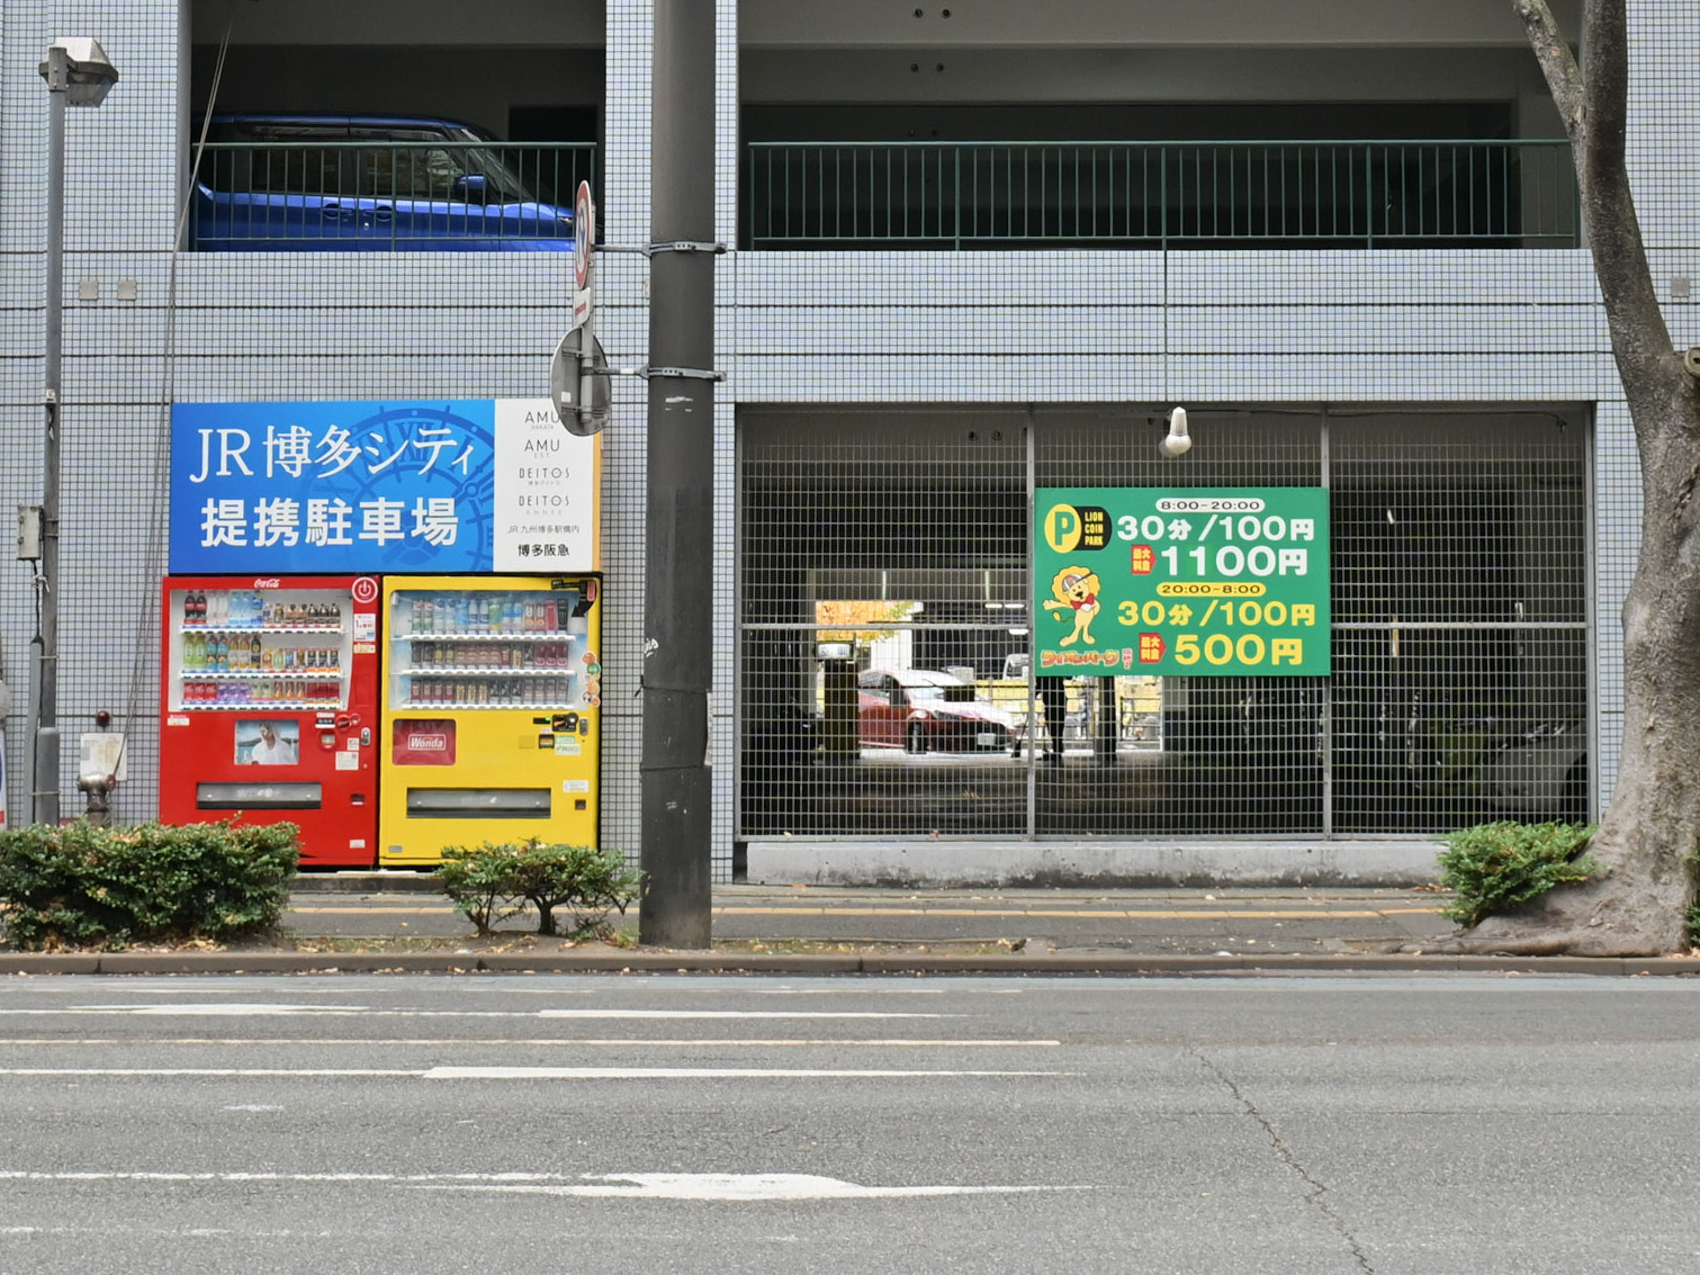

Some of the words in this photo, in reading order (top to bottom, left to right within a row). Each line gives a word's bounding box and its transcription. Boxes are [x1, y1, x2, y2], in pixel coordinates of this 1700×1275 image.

[524, 438, 560, 452] AMU
[518, 467, 570, 479] DEITOS
[518, 495, 570, 507] DEITOS
[200, 497, 459, 548] 提携駐車場
[1084, 512, 1103, 522] LION
[1054, 511, 1075, 546] P
[1084, 524, 1103, 534] COIN
[1084, 535, 1103, 546] PARK
[518, 543, 570, 557] 博多阪急
[1161, 545, 1308, 577] 1100円
[1174, 633, 1303, 666] 500円
[410, 736, 444, 749] Wonda
